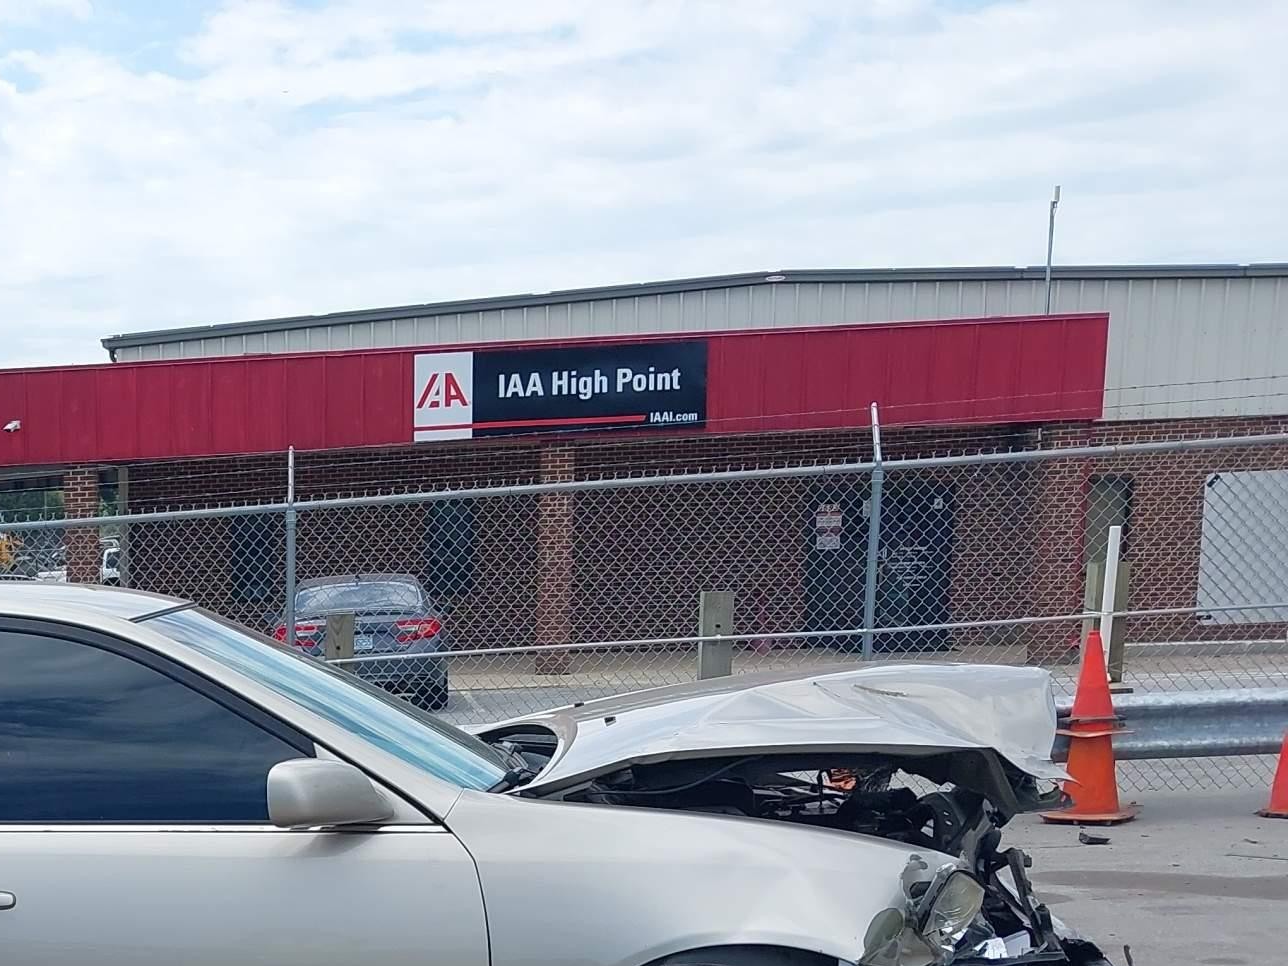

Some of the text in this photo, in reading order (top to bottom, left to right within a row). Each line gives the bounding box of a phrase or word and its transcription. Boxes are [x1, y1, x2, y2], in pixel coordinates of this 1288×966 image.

[498, 367, 681, 400] IAA High Point
[649, 411, 698, 423] IAAI.com
